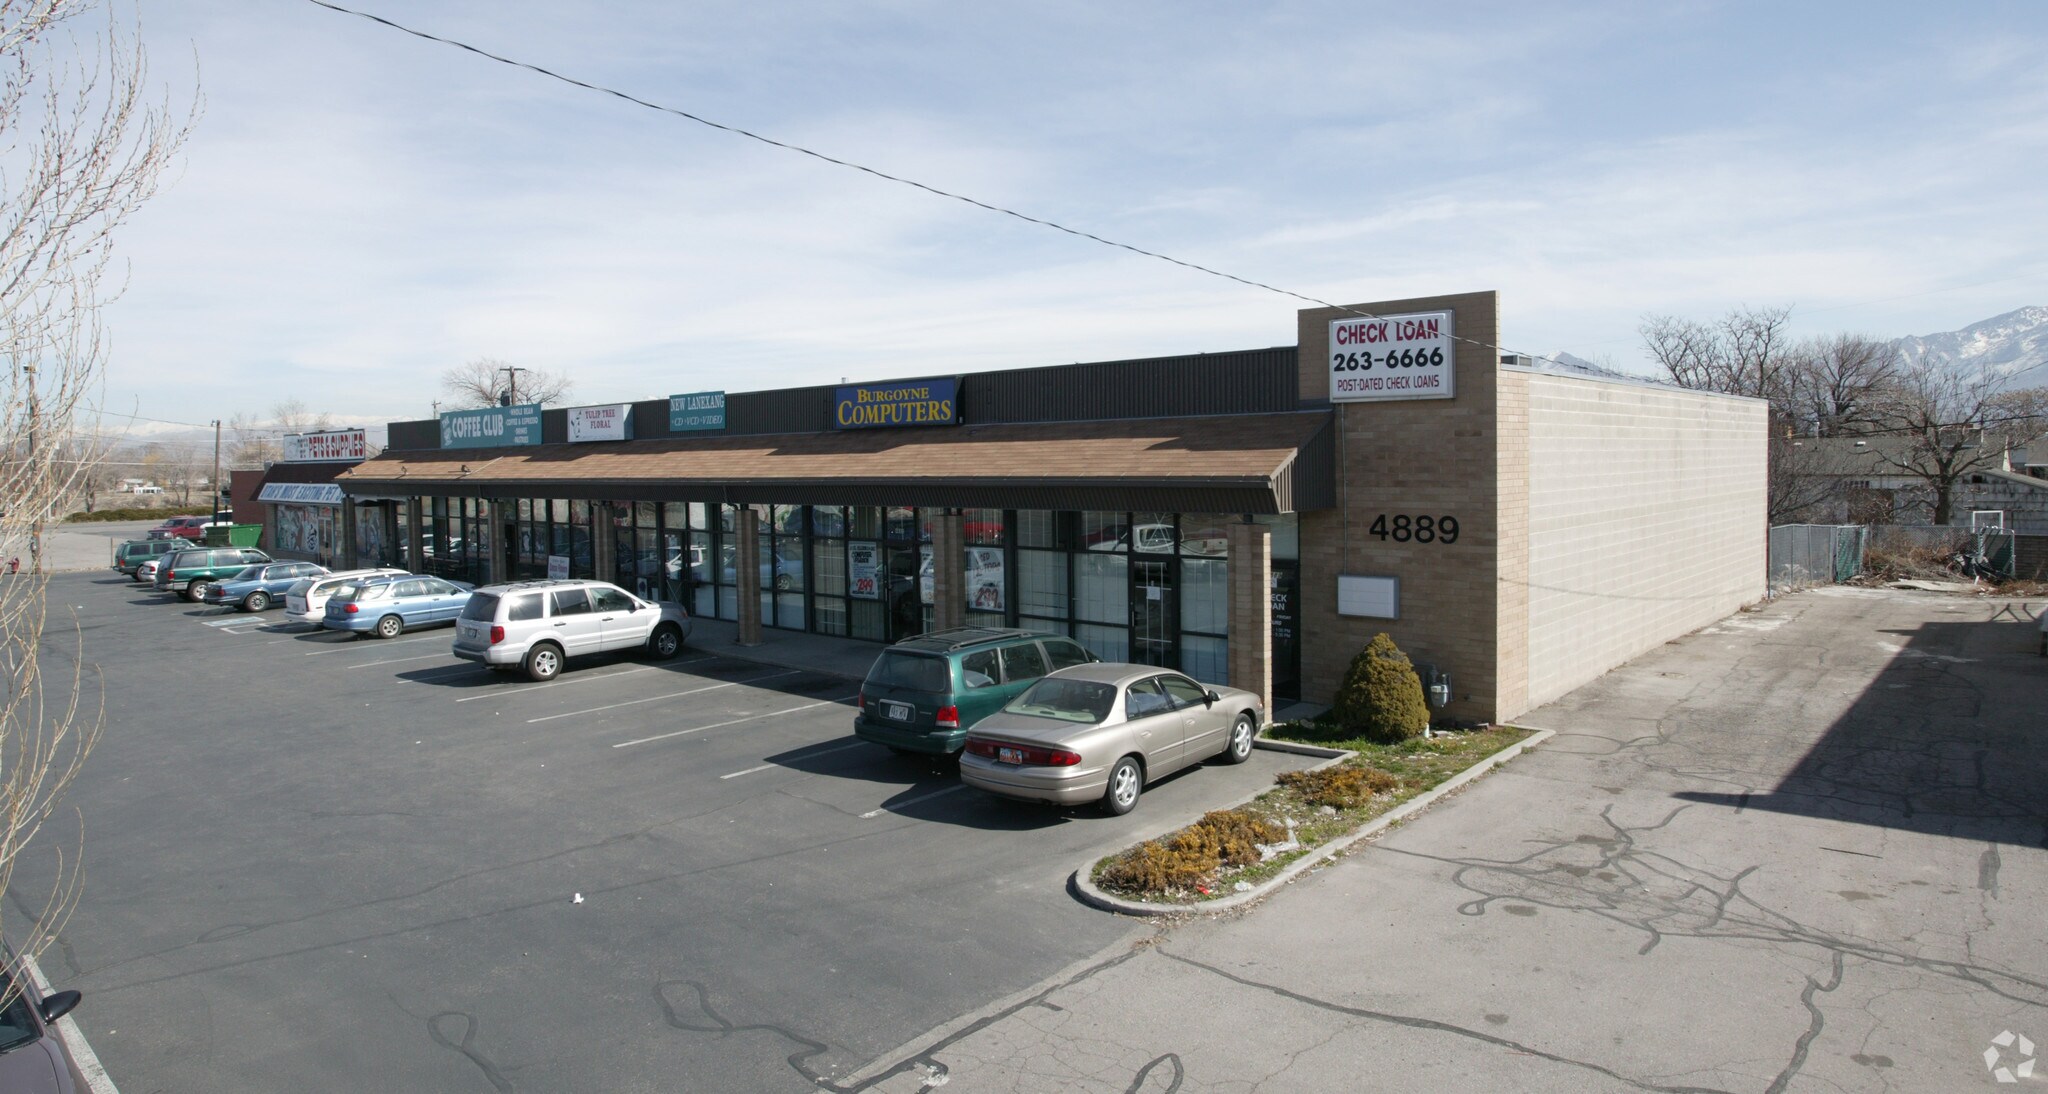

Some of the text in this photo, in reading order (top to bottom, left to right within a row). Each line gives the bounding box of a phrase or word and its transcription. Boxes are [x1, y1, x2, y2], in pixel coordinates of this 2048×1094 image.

[1336, 319, 1438, 345] CHECK LOAN
[1333, 346, 1445, 372] 263-6666
[1337, 374, 1440, 391] POST-DATED CHECK LOANS
[585, 408, 616, 419] TULIP TREE
[670, 397, 686, 412] NEW
[452, 416, 482, 438] COFFEE
[482, 413, 504, 437] CLUB
[590, 420, 611, 429] FLORAL
[308, 436, 325, 458] PETS
[331, 432, 363, 458] SUPPLIES
[1369, 514, 1460, 545] 4889
[1270, 593, 1287, 603] ECK
